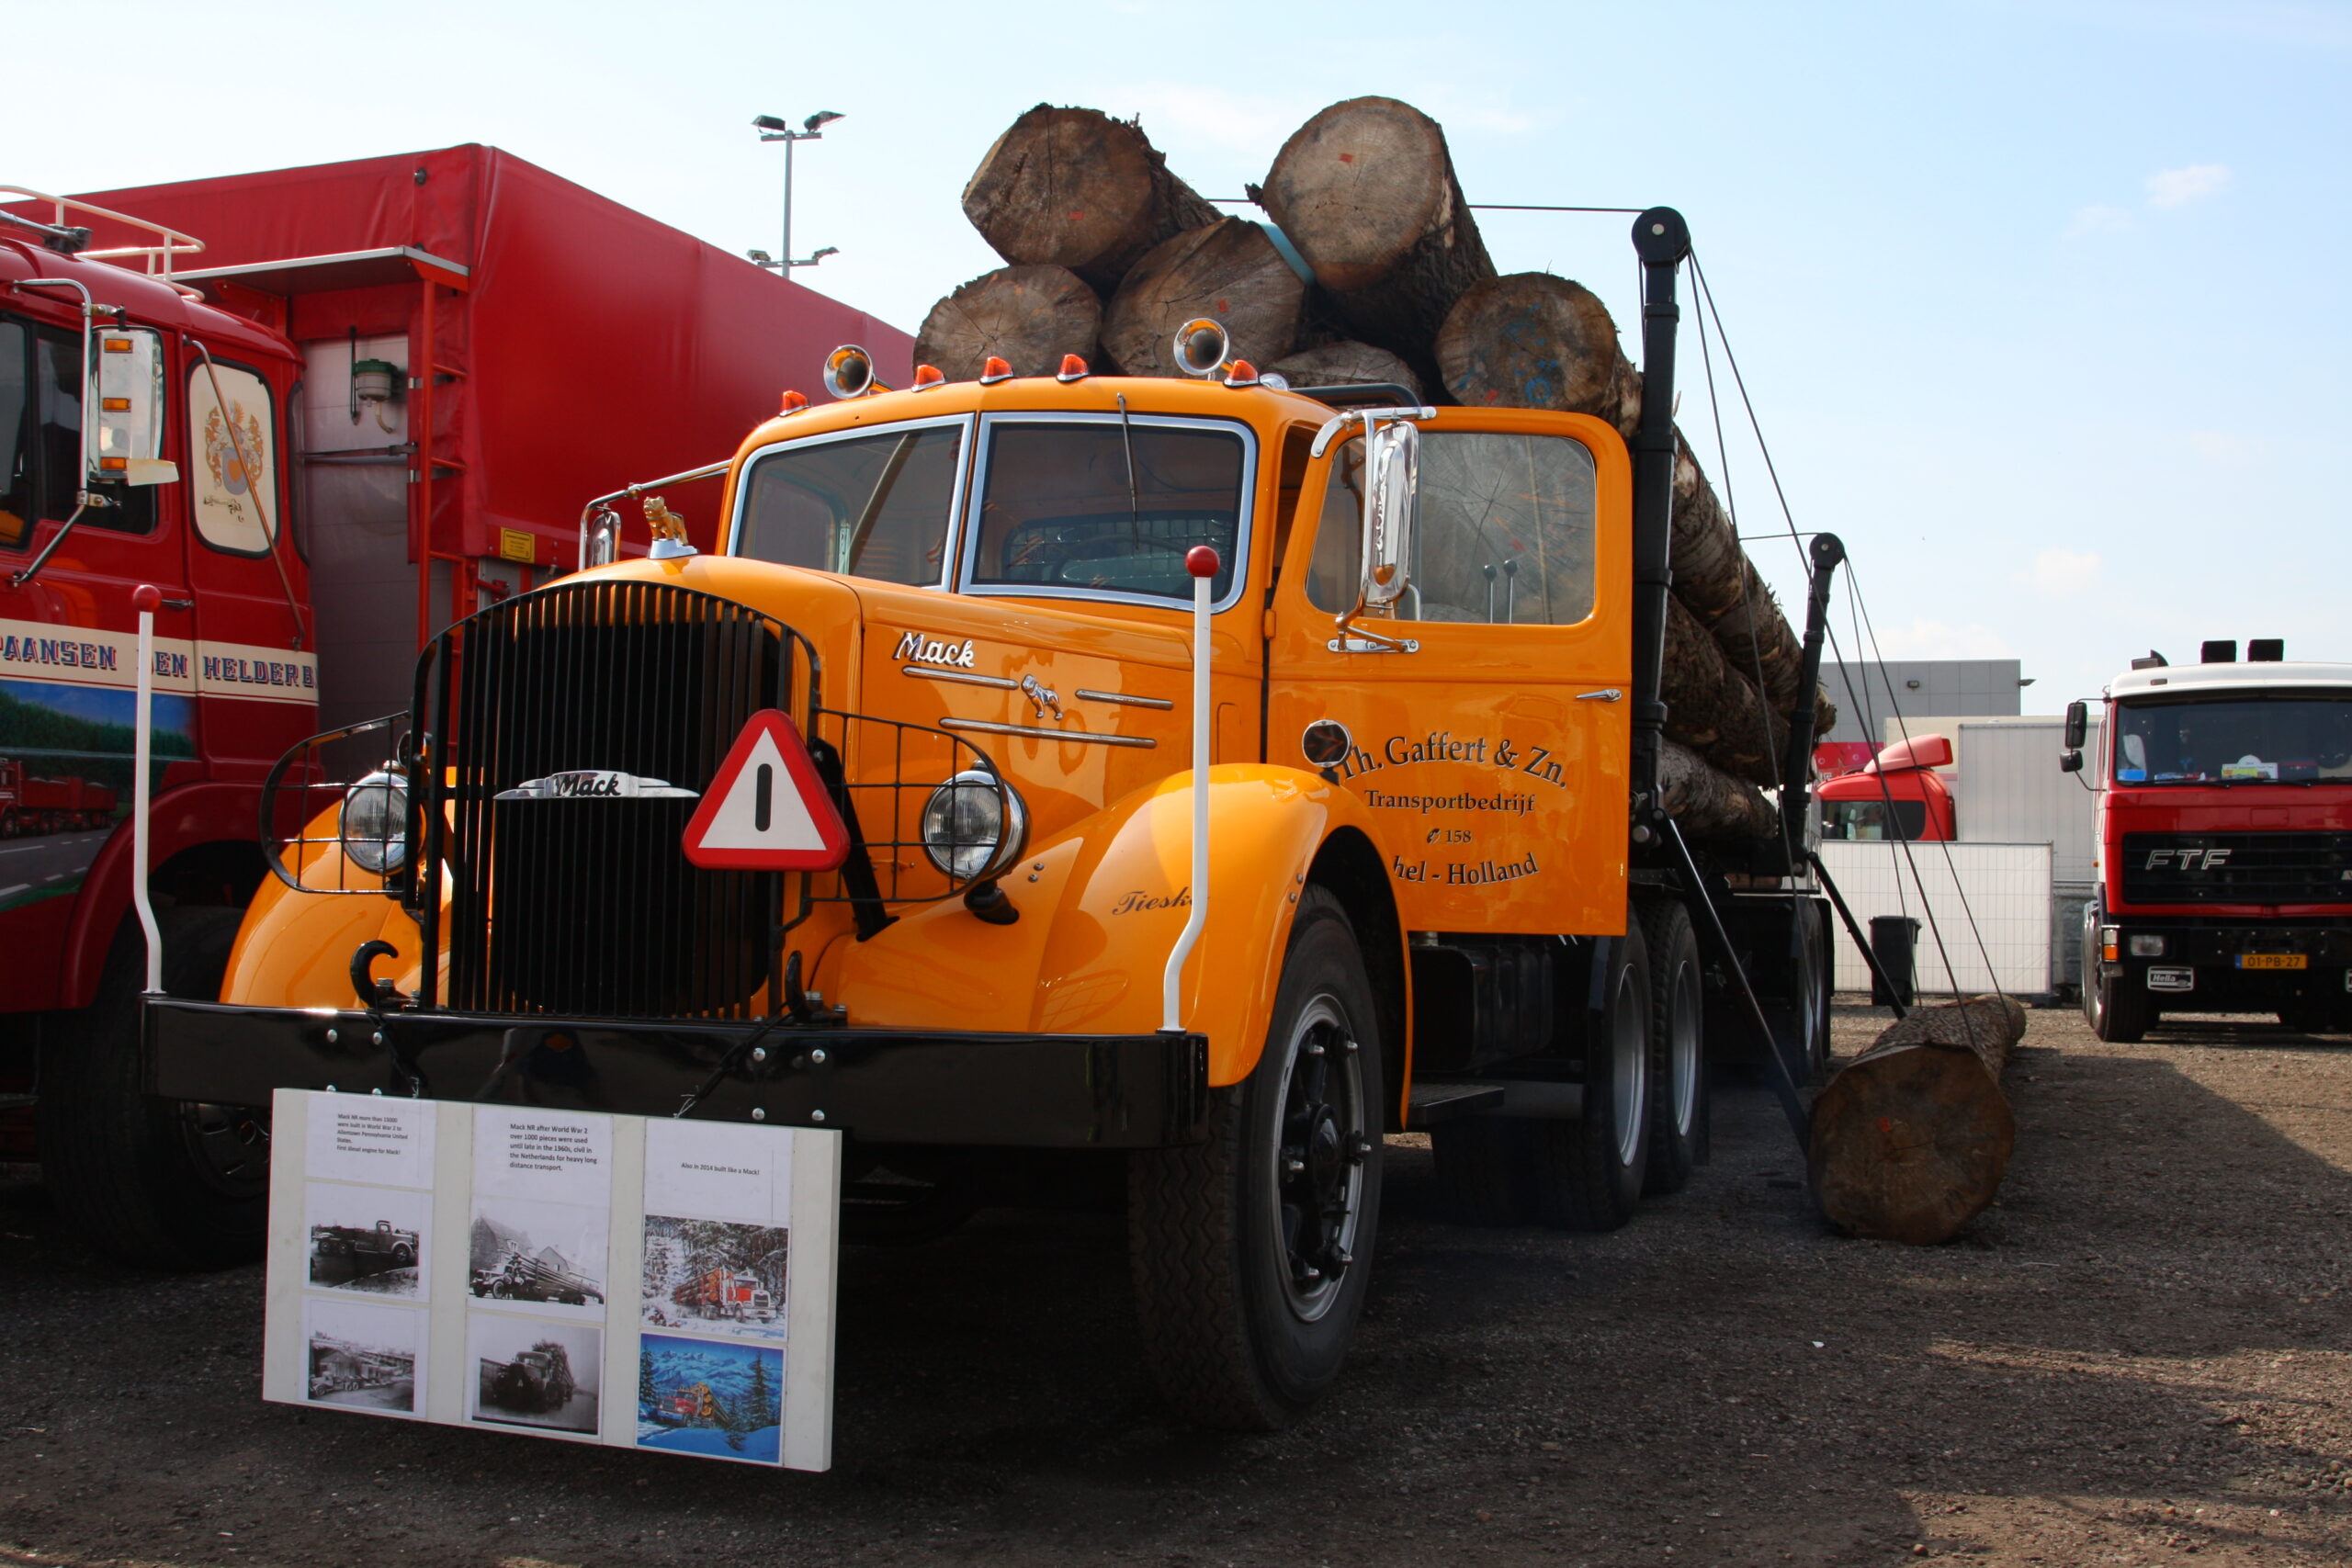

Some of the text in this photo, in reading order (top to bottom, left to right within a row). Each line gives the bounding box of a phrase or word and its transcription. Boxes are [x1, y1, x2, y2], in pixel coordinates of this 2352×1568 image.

[0, 635, 117, 671] AANSEN
[136, 648, 187, 678] EN
[203, 655, 299, 686] HELDER
[892, 631, 975, 668] Mack
[1385, 731, 1487, 765] Gaffert
[1493, 739, 1519, 769] &
[1523, 746, 1566, 788] Zn.
[553, 773, 621, 796] Mack
[1364, 789, 1535, 817] Transportbedrijf
[1445, 829, 1472, 843] 158
[1393, 855, 1427, 883] hel
[1447, 852, 1539, 886] Holland
[2145, 849, 2232, 870] FTF
[2247, 956, 2301, 968] 01-PB-27
[2153, 974, 2177, 982] Hella
[510, 1161, 563, 1171] distance transport.
[520, 1153, 555, 1161] Netherlands
[566, 1156, 583, 1164] heavy
[584, 1156, 597, 1165] long
